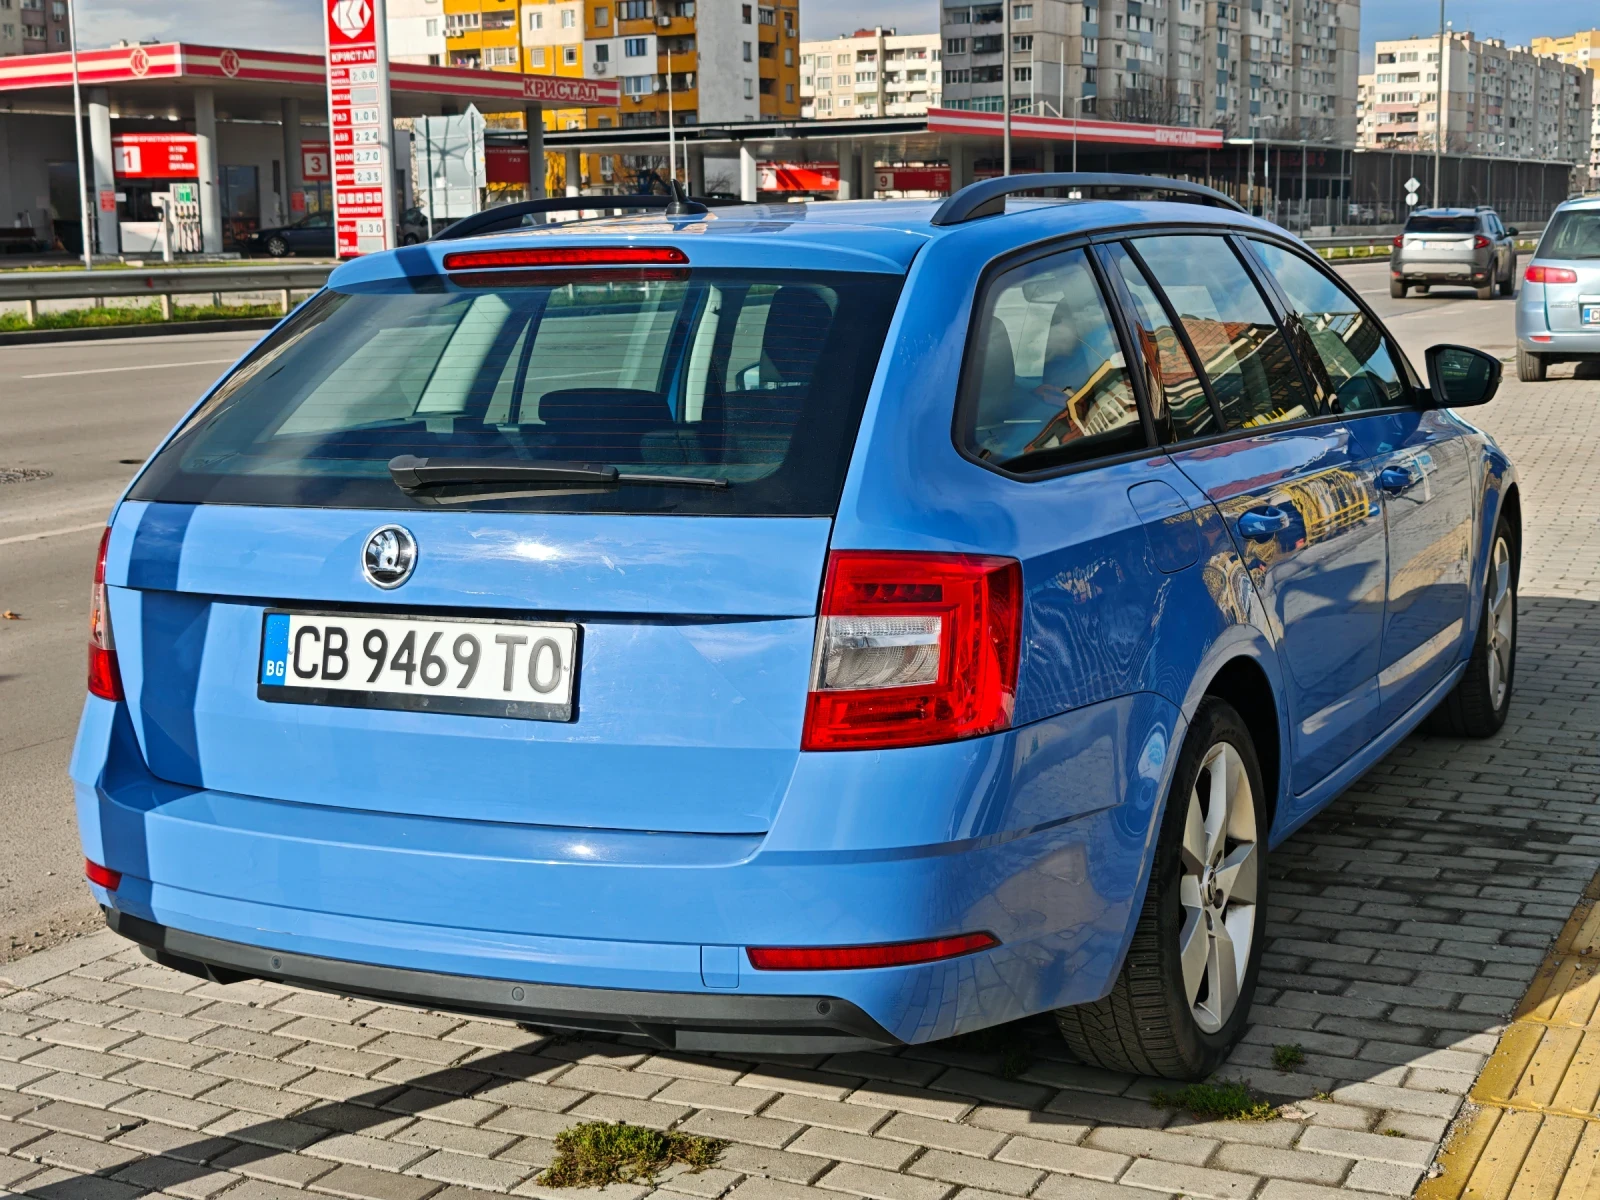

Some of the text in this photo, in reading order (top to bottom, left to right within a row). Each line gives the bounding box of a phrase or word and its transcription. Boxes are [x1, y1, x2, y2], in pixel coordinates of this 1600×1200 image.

[331, 49, 375, 63] КРИСТАЛ
[353, 70, 375, 81] 2.00
[523, 78, 599, 101] КРИСТАЛ
[356, 131, 378, 141] 2.24
[122, 150, 132, 168] 1
[357, 151, 379, 162] 2.70
[311, 156, 322, 172] 3
[357, 172, 379, 182] 2.35
[762, 173, 769, 185] 7
[879, 176, 888, 187] 9
[360, 224, 382, 233] 1.30
[293, 625, 563, 694] CB 9469 TO
[266, 661, 285, 676] BG
